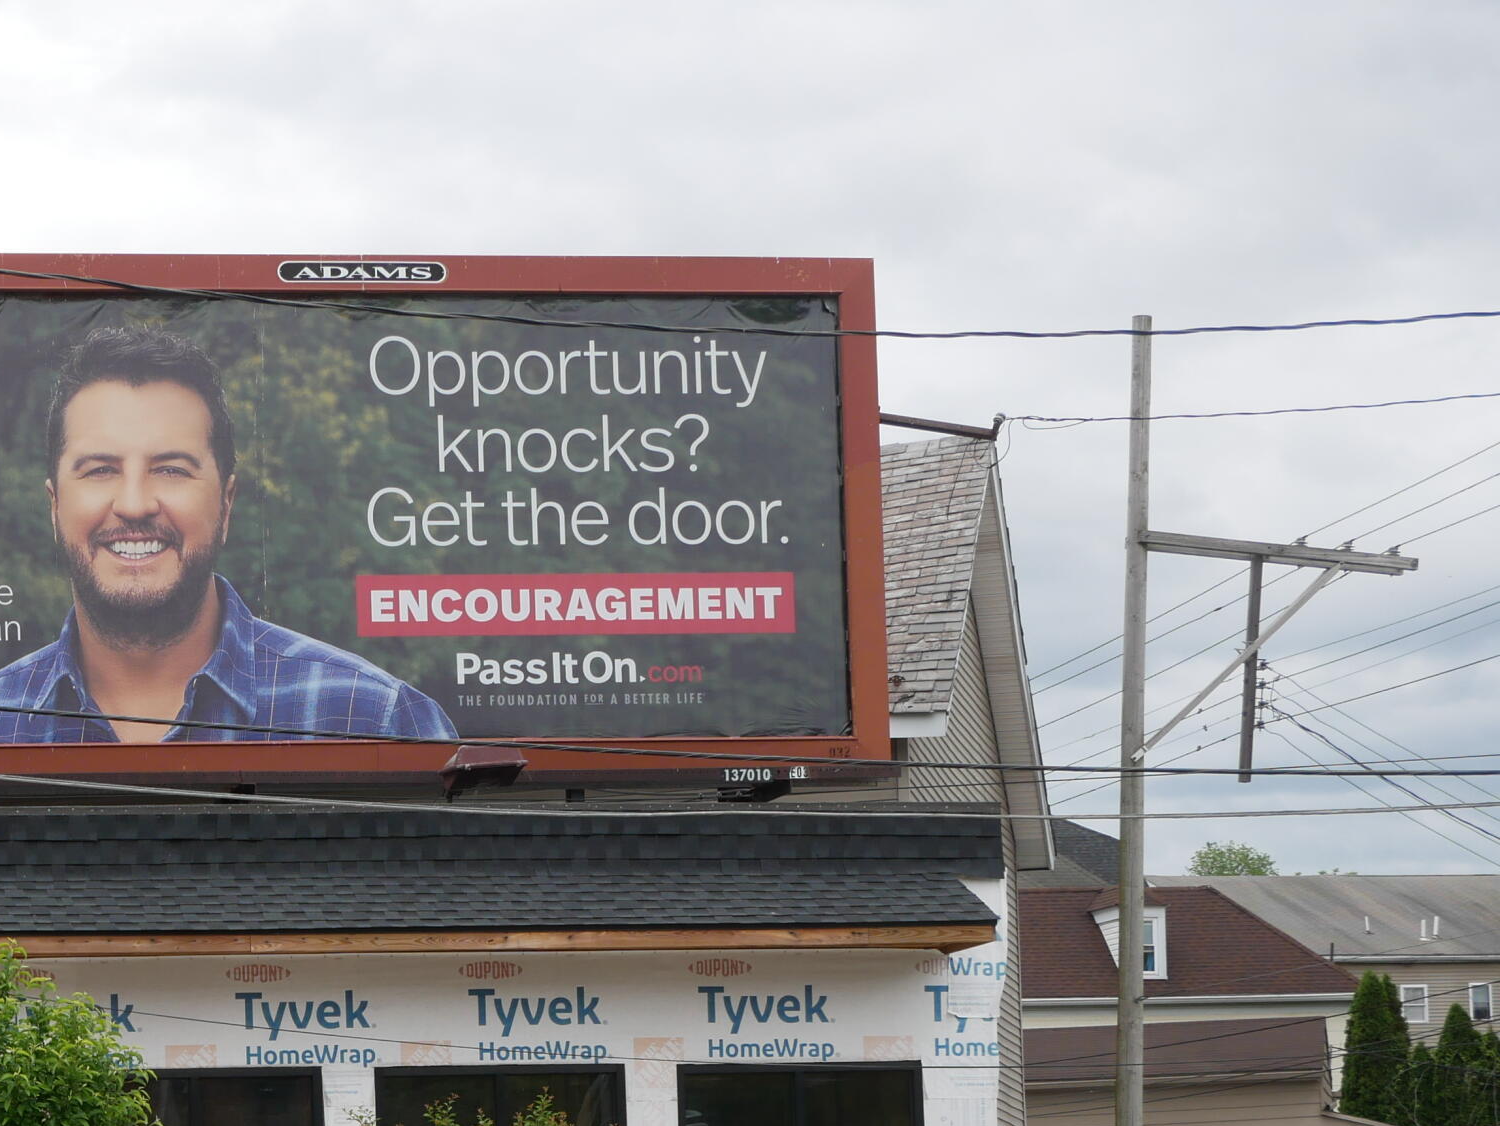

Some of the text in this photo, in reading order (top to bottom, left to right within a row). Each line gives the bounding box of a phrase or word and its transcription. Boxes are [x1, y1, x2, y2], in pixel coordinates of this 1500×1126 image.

[292, 263, 433, 281] ADAMS
[369, 335, 766, 407] Opportunity
[437, 413, 710, 473] knocks?
[367, 487, 790, 547] Get the door.
[370, 587, 783, 623] ENCOURAGEMENT
[458, 692, 703, 706] THE FOUNDATION FOR A BETTER LIFE
[724, 768, 771, 782] 137010
[233, 964, 285, 983] DUPONT
[465, 961, 516, 980] DUPONT
[696, 958, 745, 977] DUPONT
[235, 990, 372, 1040] Tyvek
[468, 986, 602, 1037] Tyvek
[698, 985, 830, 1034] Tyvek
[245, 1045, 376, 1068] HomeWrap
[478, 1040, 607, 1064] HomeWrap
[708, 1038, 835, 1061] HomeWrap
